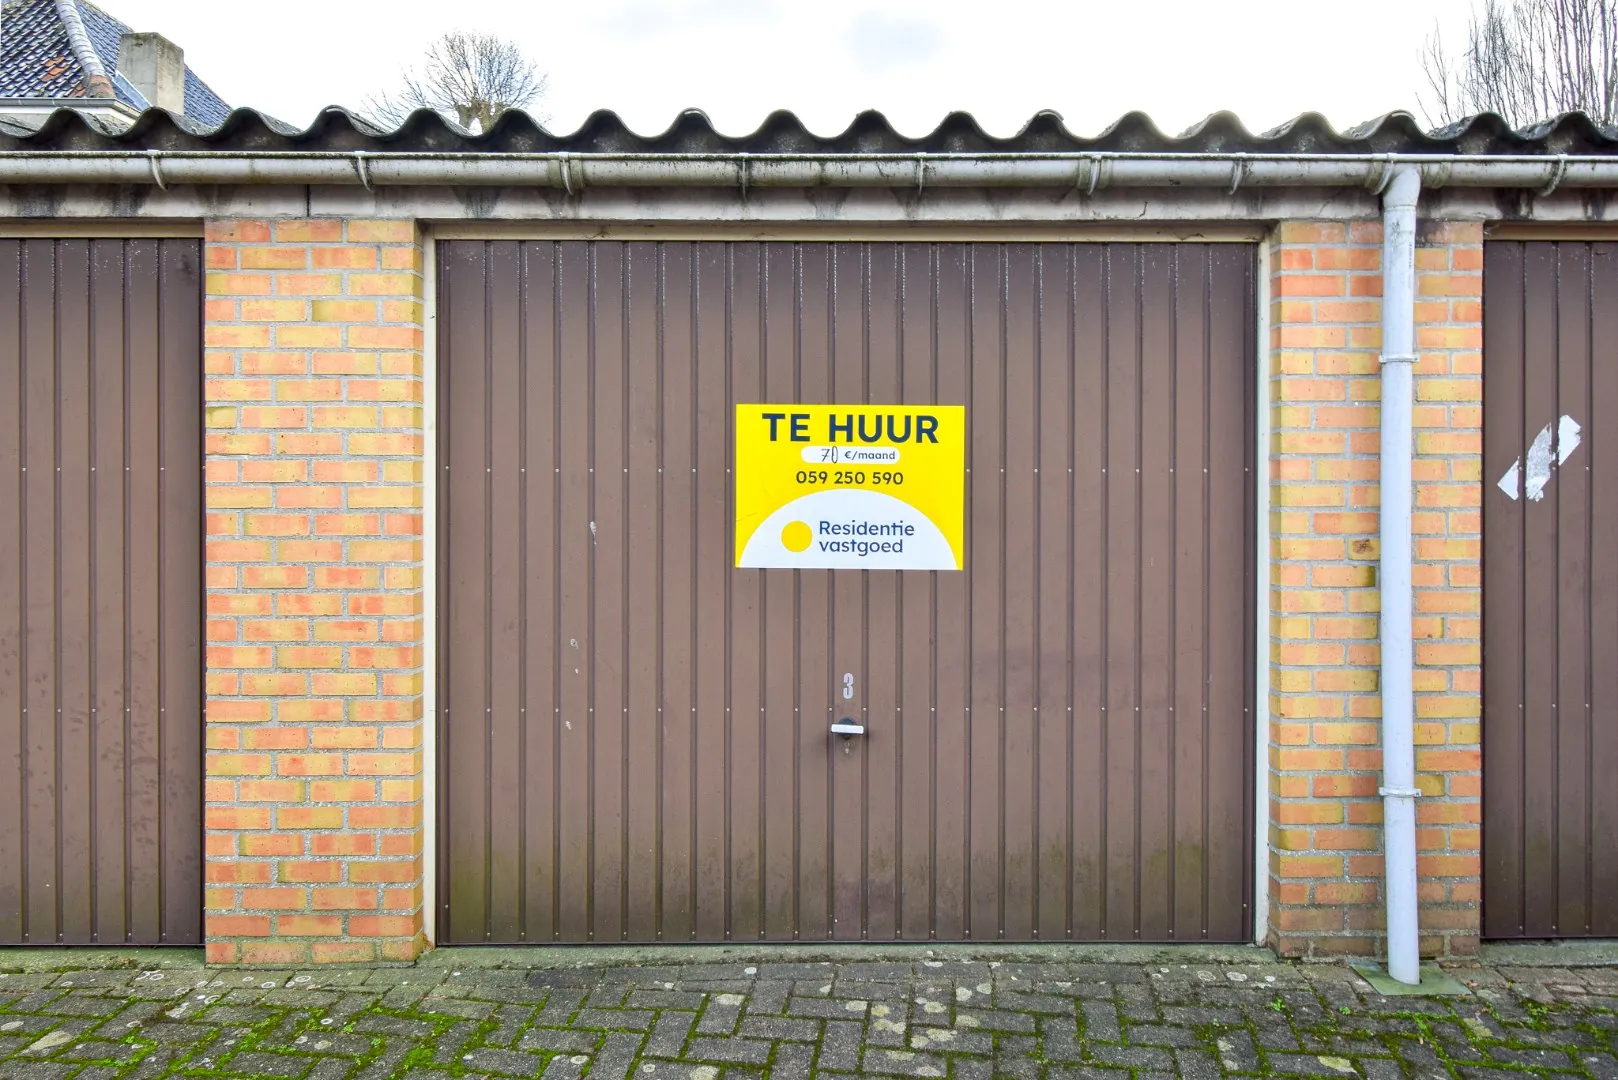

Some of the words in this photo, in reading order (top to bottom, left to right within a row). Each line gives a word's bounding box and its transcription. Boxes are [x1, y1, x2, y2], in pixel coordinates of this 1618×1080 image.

[762, 413, 811, 442] TE
[829, 413, 939, 444] HUUR
[821, 445, 839, 464] 70
[844, 450, 896, 461] €/maand
[796, 470, 828, 484] 059
[834, 471, 865, 485] 250
[872, 471, 904, 485] 590
[819, 519, 915, 536] Residentie
[819, 538, 903, 557] vastgoed
[843, 672, 854, 700] 3
